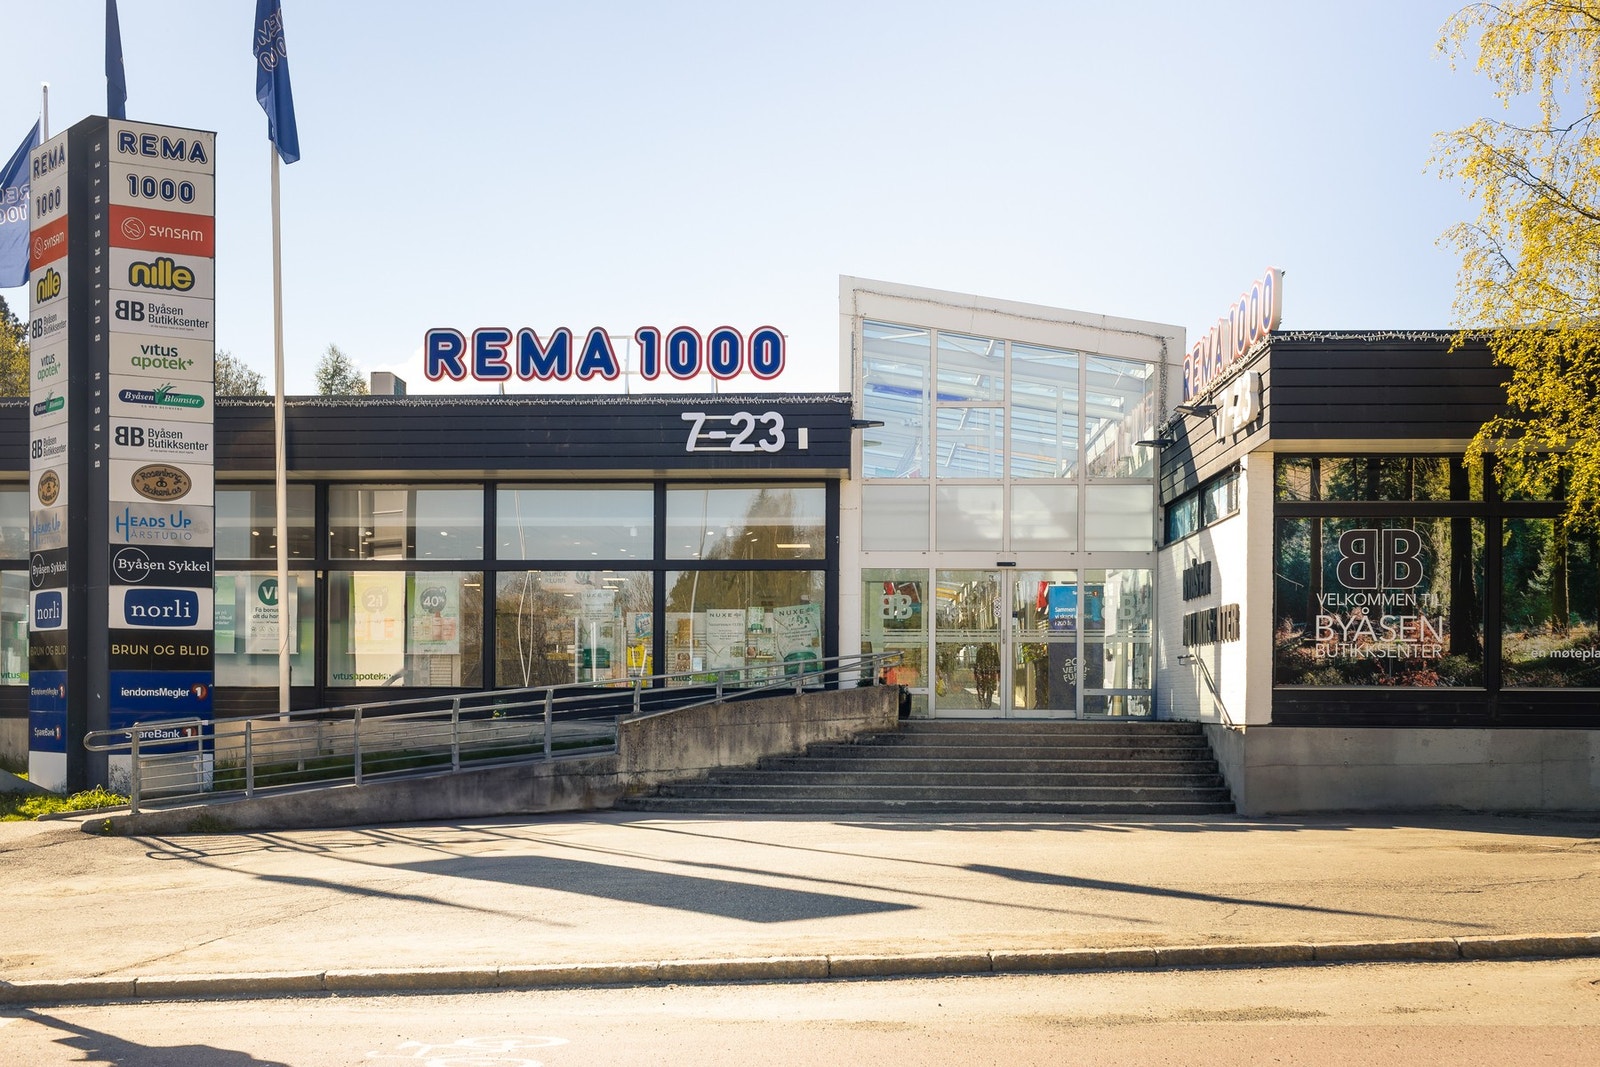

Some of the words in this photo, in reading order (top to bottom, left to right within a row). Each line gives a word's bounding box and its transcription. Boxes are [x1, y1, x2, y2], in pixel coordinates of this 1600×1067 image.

[118, 130, 208, 165] REMA
[33, 142, 65, 180] REMA
[127, 173, 195, 204] 1000
[36, 186, 61, 219] 1000
[129, 257, 195, 291] nille
[37, 267, 61, 304] nille
[148, 303, 184, 316] Byåsen
[148, 314, 210, 329] Butikksenter
[1183, 318, 1228, 402] REMA
[1228, 266, 1282, 364] 1000
[141, 344, 178, 358] vitus
[424, 326, 620, 382] REMA
[634, 325, 786, 381] 1000
[124, 391, 154, 402] Byåsen
[164, 394, 201, 405] Blomster
[148, 428, 183, 440] Byåsen
[681, 411, 785, 453] 7-23
[148, 438, 209, 451] Butikksenter
[32, 563, 50, 577] Byåsen
[50, 560, 67, 575] Sykkel
[118, 557, 165, 571] Byåsen
[168, 560, 210, 573] Sykkel
[1316, 592, 1417, 607] VELKOMMEN
[1421, 593, 1443, 607] TIL
[37, 601, 60, 620] norli
[131, 600, 191, 618] norli
[1315, 606, 1444, 643] BYÅSEN
[30, 646, 45, 657] BRUN
[45, 645, 54, 656] OG
[55, 645, 67, 655] BLID
[111, 644, 149, 655] BRUN
[153, 644, 175, 656] OG
[180, 645, 209, 656] BLID
[1315, 643, 1443, 659] BUTIKKSENTER
[1531, 650, 1546, 658] en
[121, 687, 190, 699] iendomsMegler
[195, 686, 202, 697] 1
[125, 729, 180, 739] SareBank
